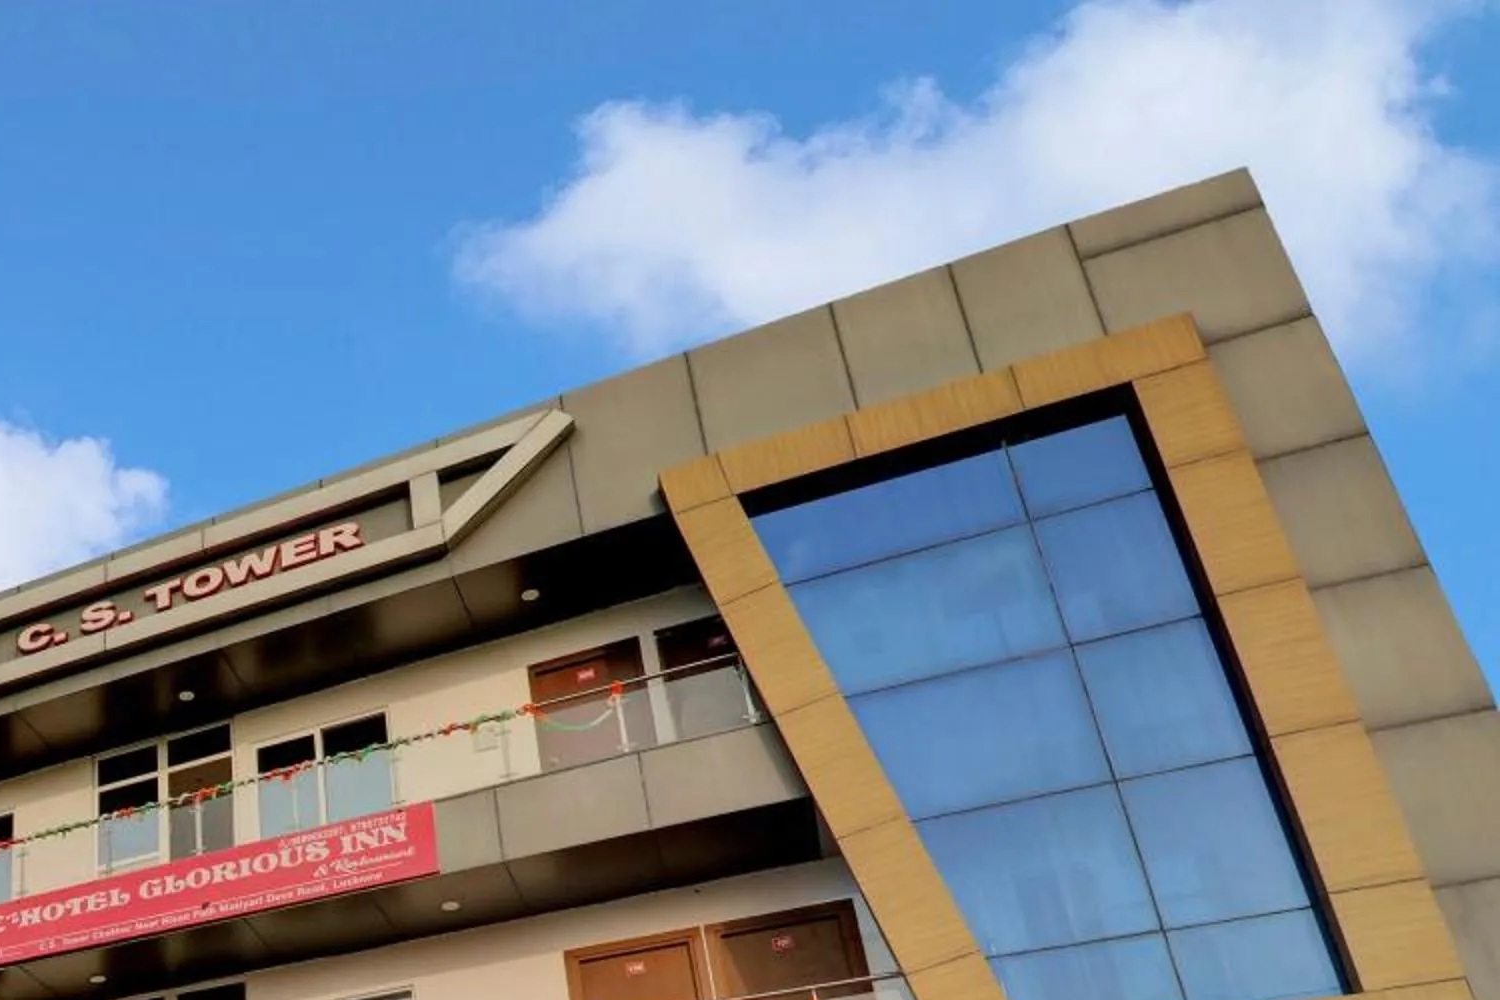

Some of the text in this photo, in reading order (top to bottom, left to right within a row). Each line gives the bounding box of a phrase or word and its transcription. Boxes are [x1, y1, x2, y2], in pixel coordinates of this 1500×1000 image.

[17, 521, 365, 654] C. S. TOWER
[19, 888, 130, 927] HOTEL
[138, 840, 330, 900] GLORIOUS
[340, 822, 408, 855] INN
